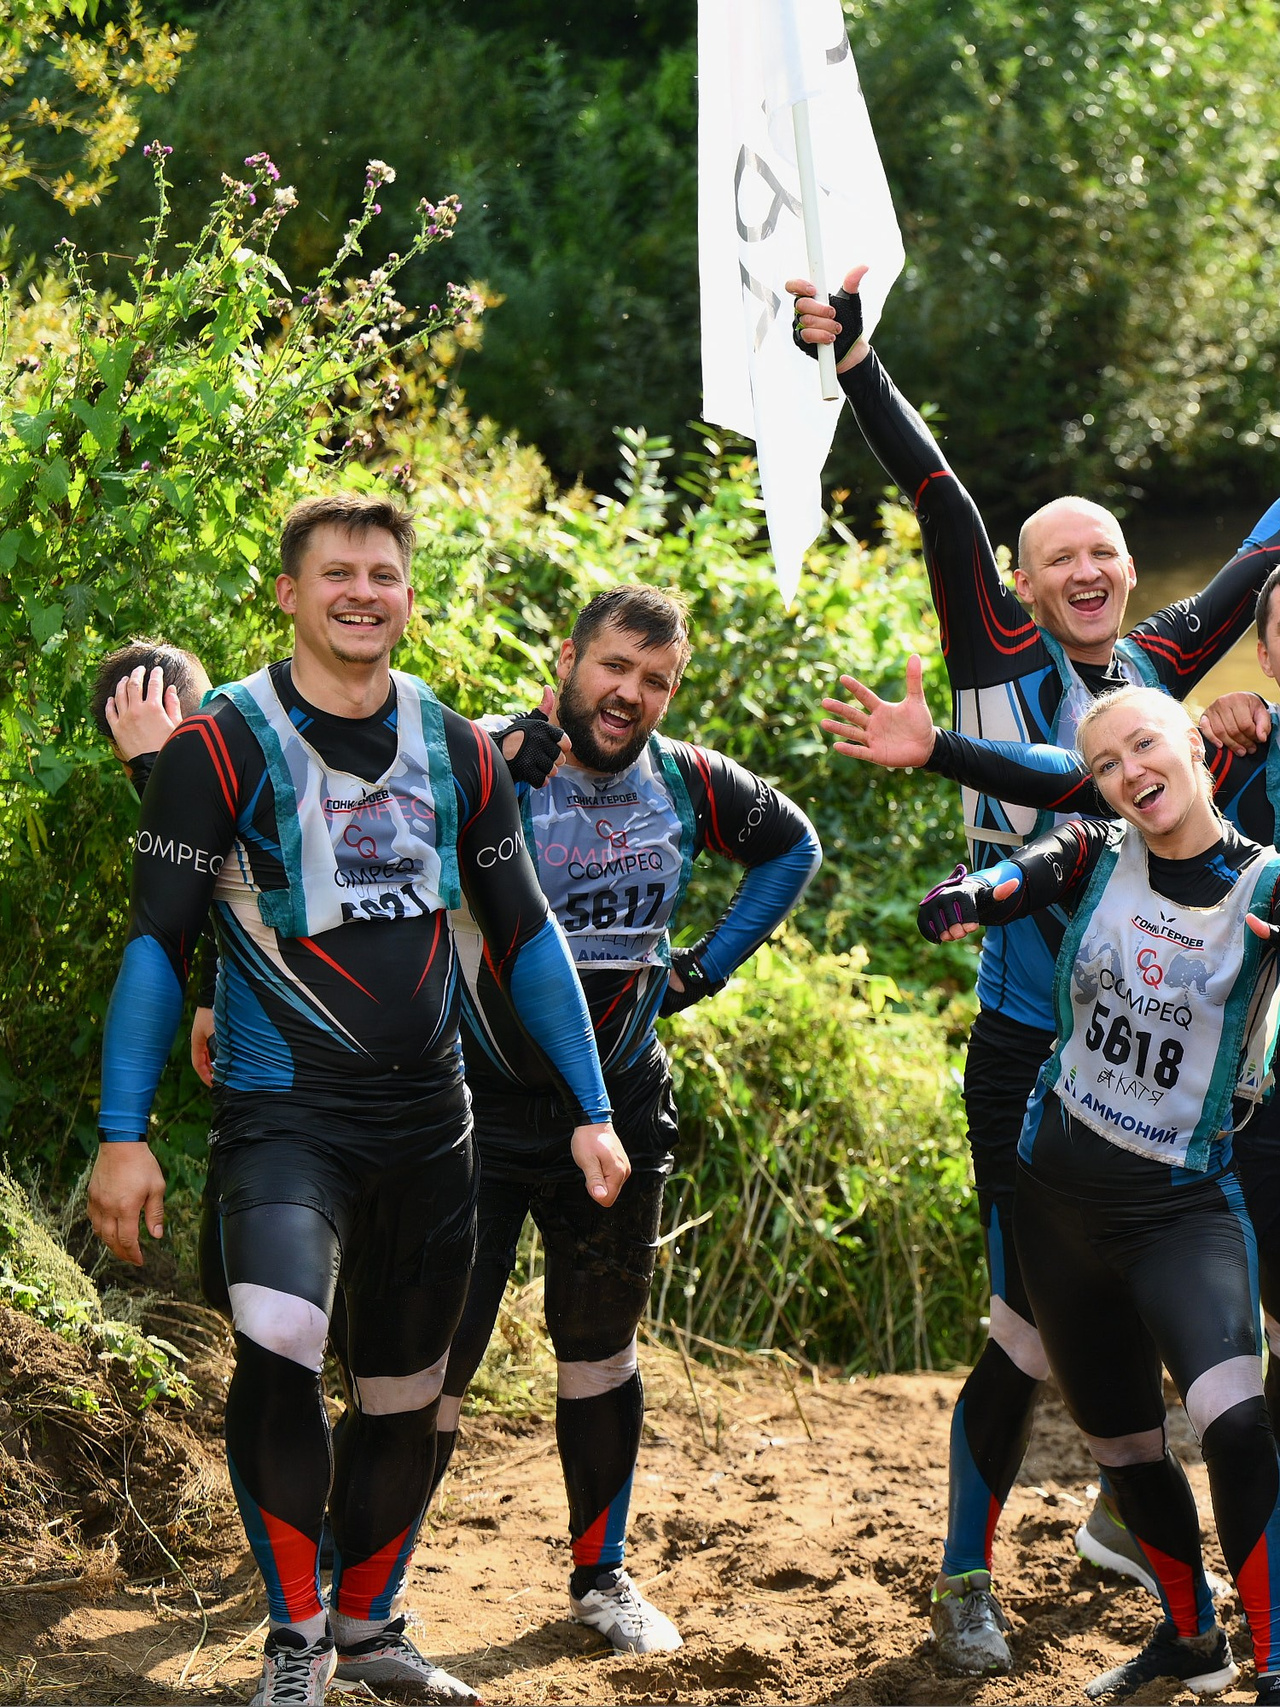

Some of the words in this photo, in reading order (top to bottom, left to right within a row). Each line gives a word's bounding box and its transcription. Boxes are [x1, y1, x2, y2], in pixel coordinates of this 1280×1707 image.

[566, 793, 600, 806] ГОНКА
[600, 791, 638, 806] ГЕРОЕВ
[567, 851, 664, 880] COMPEQ
[563, 882, 667, 933] 5617
[1160, 926, 1205, 948] ГЕРОЕВ
[1099, 968, 1193, 1032] COMPEQ
[1085, 999, 1184, 1090] 5618
[1080, 1092, 1179, 1145] АММОНИЙ
